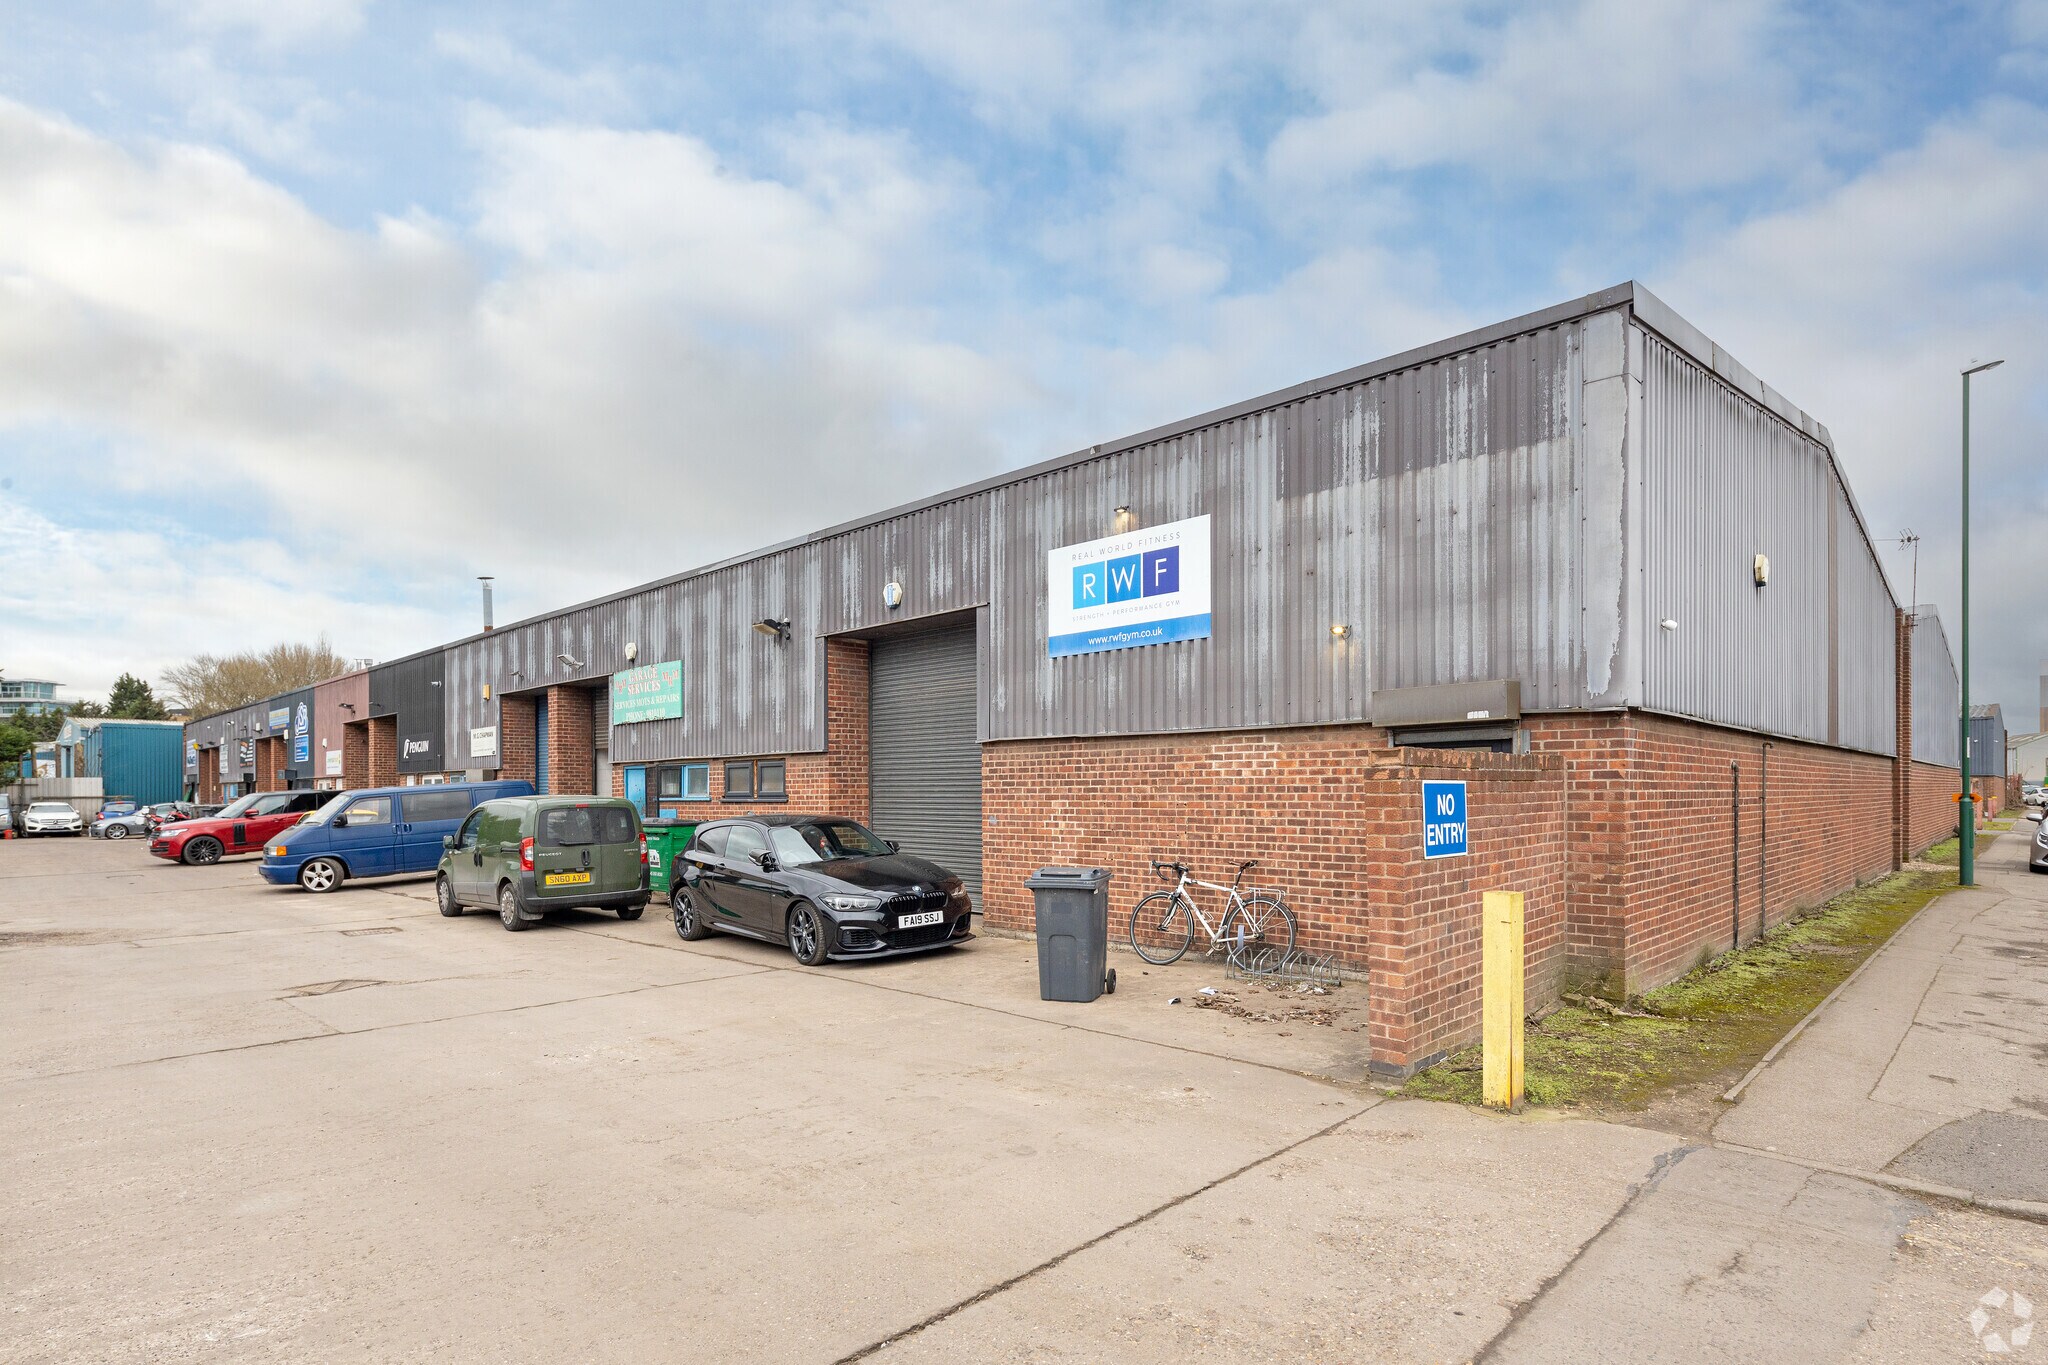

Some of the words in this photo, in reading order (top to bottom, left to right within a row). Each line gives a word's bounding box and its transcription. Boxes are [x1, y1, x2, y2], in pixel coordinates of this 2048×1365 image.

[1072, 551, 1093, 561] REAL
[1099, 542, 1133, 555] WORLD
[1138, 532, 1181, 546] FITNESS
[1073, 612, 1104, 622] STRENGTH
[1113, 603, 1162, 615] PERFORMANCE
[1088, 626, 1163, 645] www.rwfgym.co.uk
[628, 667, 658, 682] GARAGE
[627, 680, 661, 695] SERVICES
[656, 694, 680, 704] REPAIRS
[409, 740, 429, 753] PENGUIN
[1437, 793, 1455, 816] NO
[1426, 822, 1465, 846] ENTRY
[549, 875, 570, 884] SN60
[572, 874, 587, 882] AXP
[904, 915, 923, 926] FA19
[924, 913, 939, 923] SSJ
